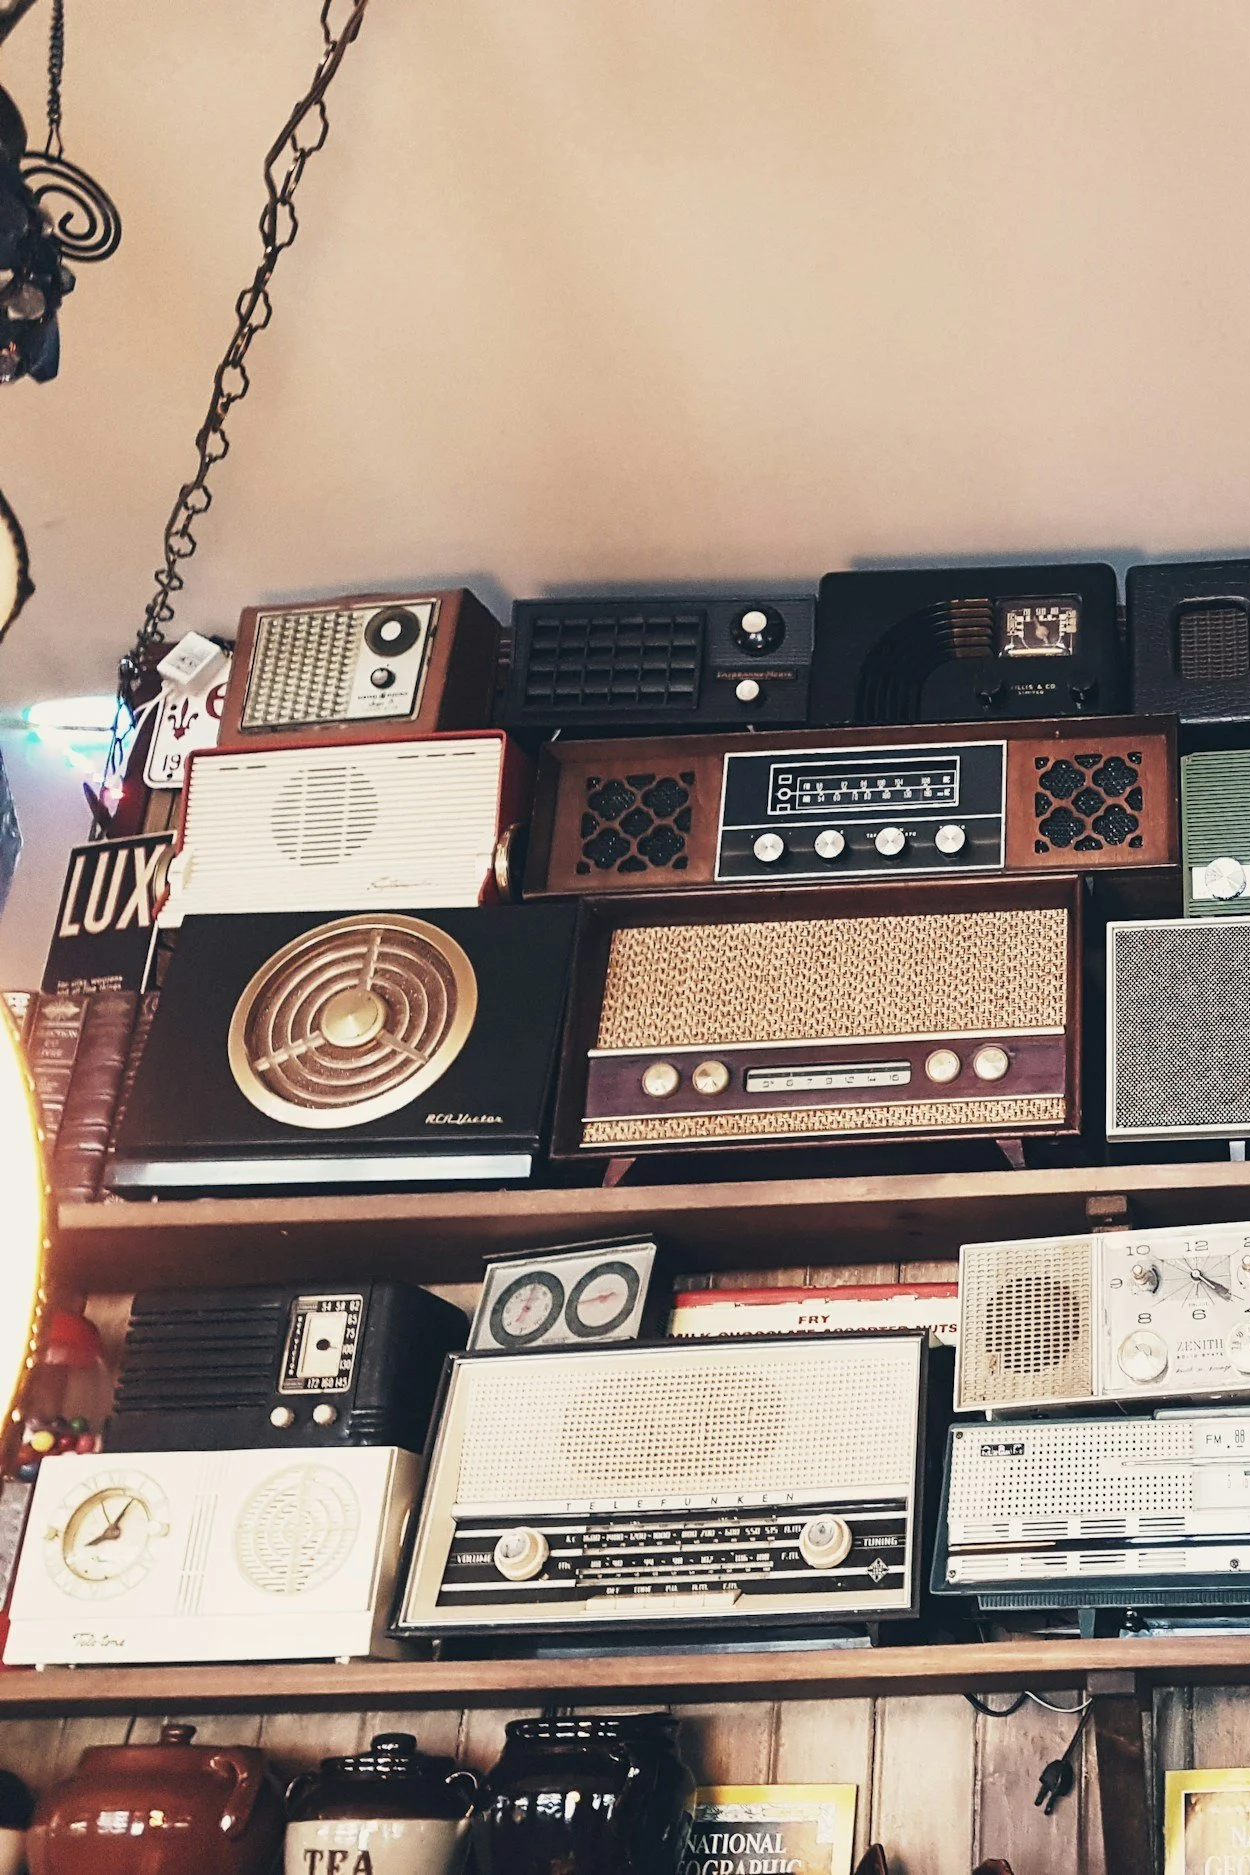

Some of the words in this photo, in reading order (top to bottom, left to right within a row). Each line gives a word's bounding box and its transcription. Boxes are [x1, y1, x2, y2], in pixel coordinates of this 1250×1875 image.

[58, 843, 167, 938] LUX
[1126, 1244, 1150, 1256] 10
[1185, 1241, 1208, 1252] 12
[1110, 1278, 1123, 1289] 9
[798, 1315, 831, 1325] FRY
[1137, 1313, 1152, 1324] 8
[1192, 1309, 1206, 1320] 6
[1177, 1338, 1223, 1351] ZENITH
[1206, 1434, 1222, 1444] FM
[1234, 1429, 1245, 1443] 88
[566, 1493, 794, 1511] TELEFUNKEN
[863, 1536, 898, 1547] TUNING
[686, 1832, 787, 1855] NATIONAL
[303, 1850, 373, 1875] TEA
[676, 1858, 802, 1875] EOGRAPHIC
